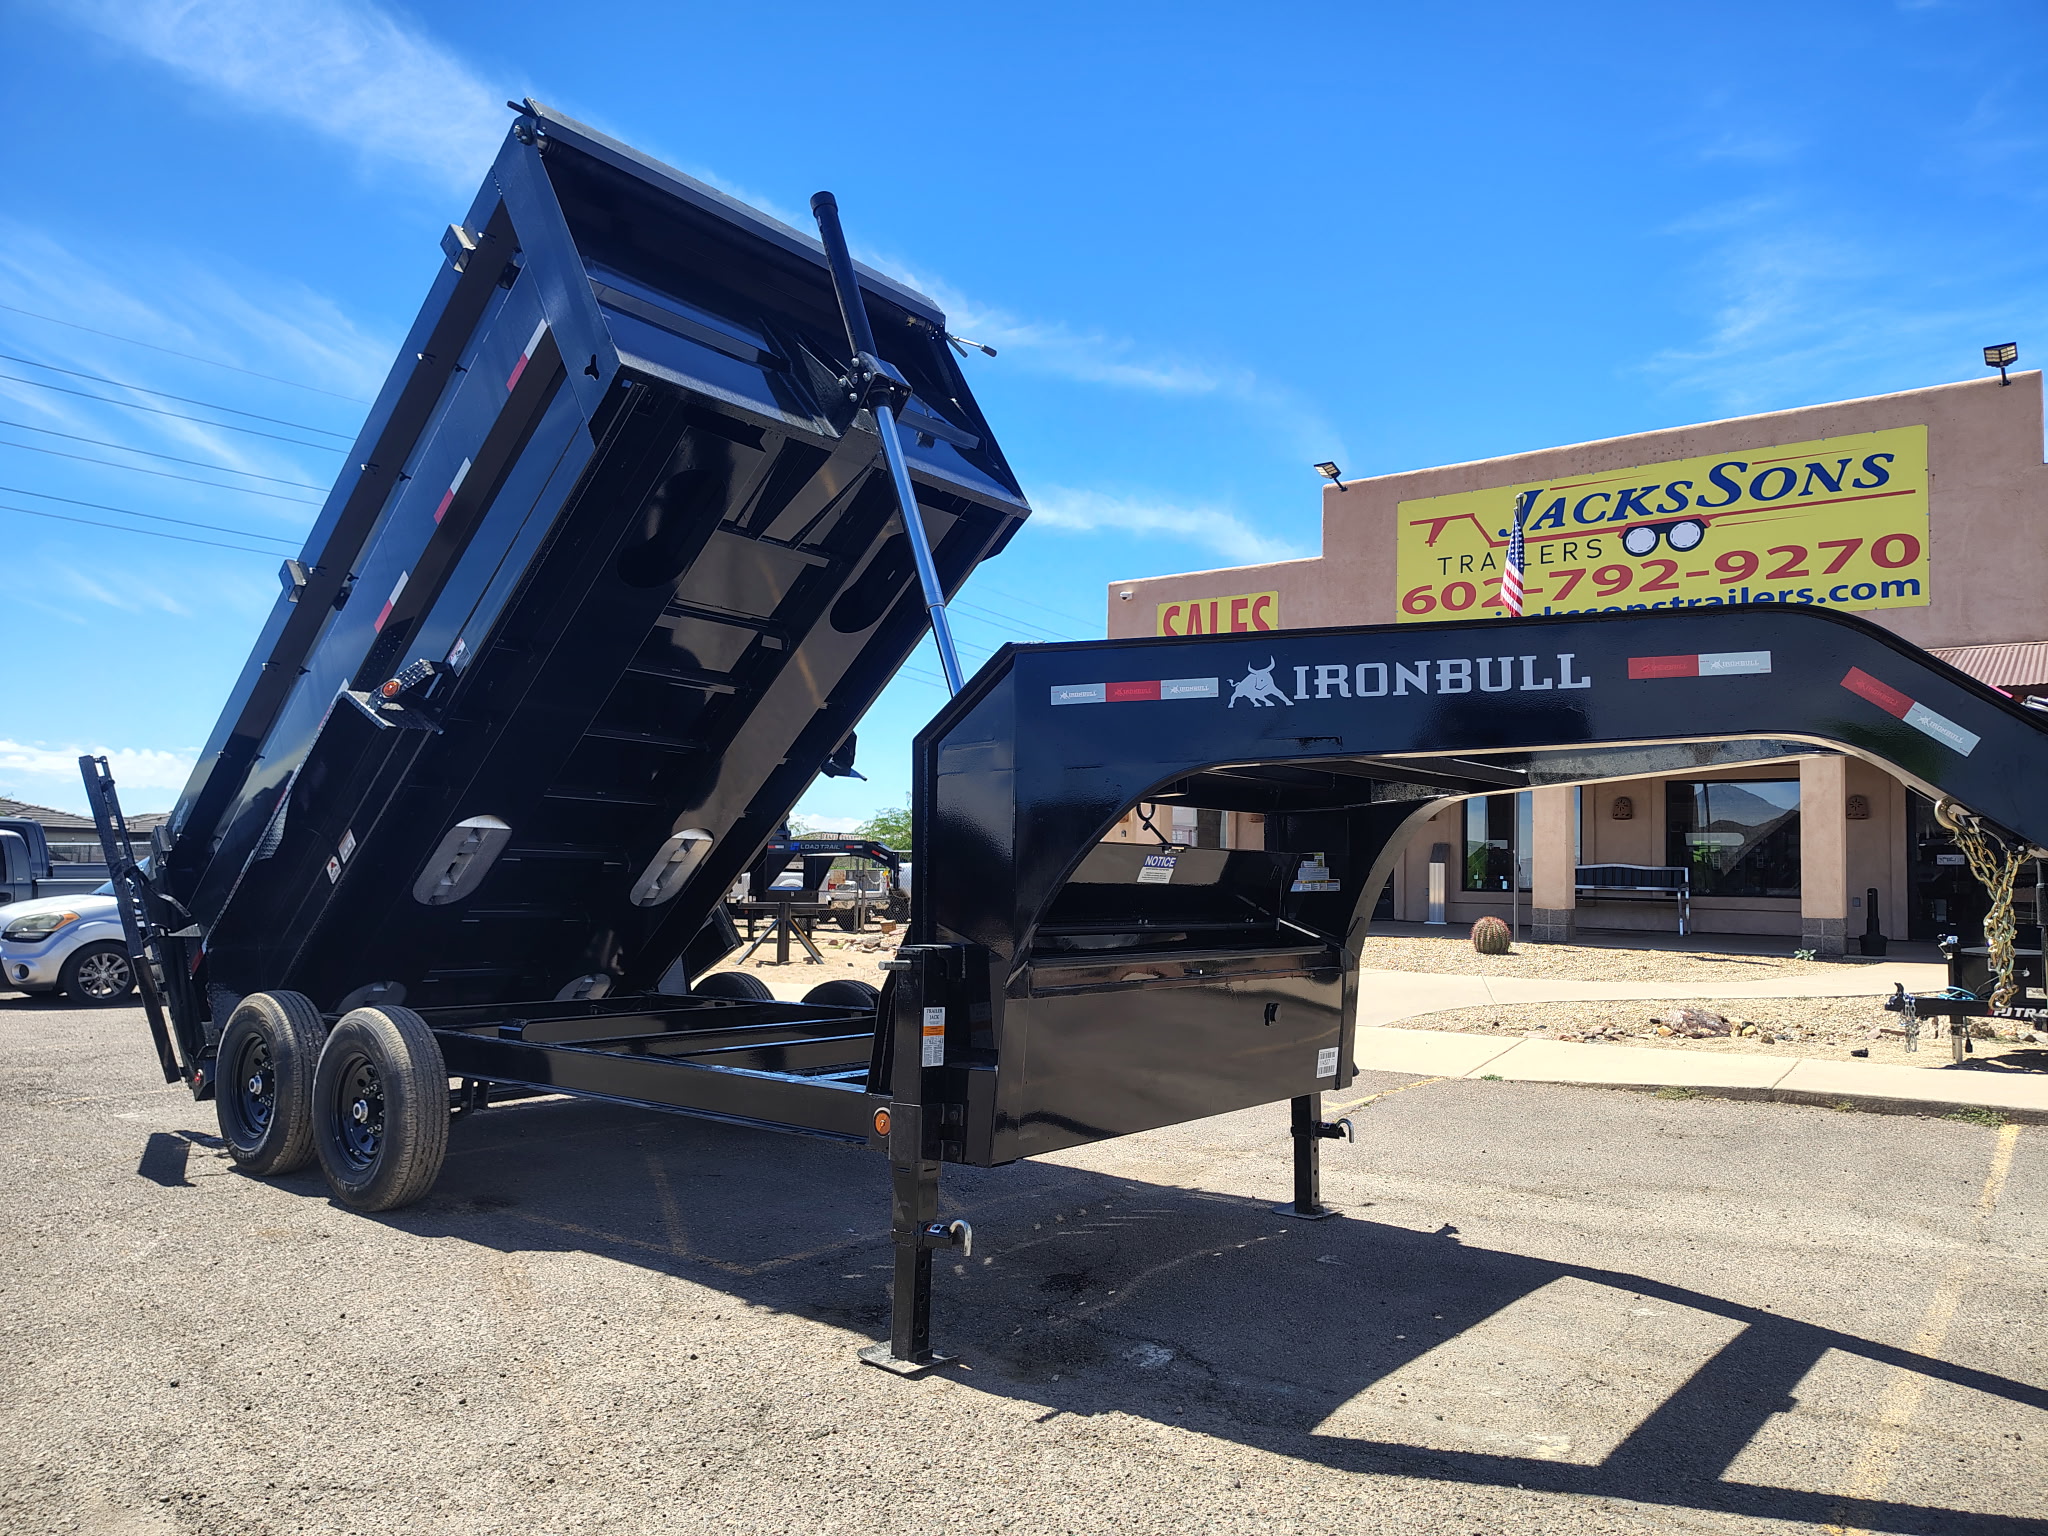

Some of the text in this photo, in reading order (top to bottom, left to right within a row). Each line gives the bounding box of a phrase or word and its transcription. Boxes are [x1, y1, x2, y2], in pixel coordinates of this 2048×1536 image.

[1437, 538, 1603, 576] TRAERS
[1293, 653, 1592, 700] IRONBULL
[1145, 855, 1176, 867] NOTICE
